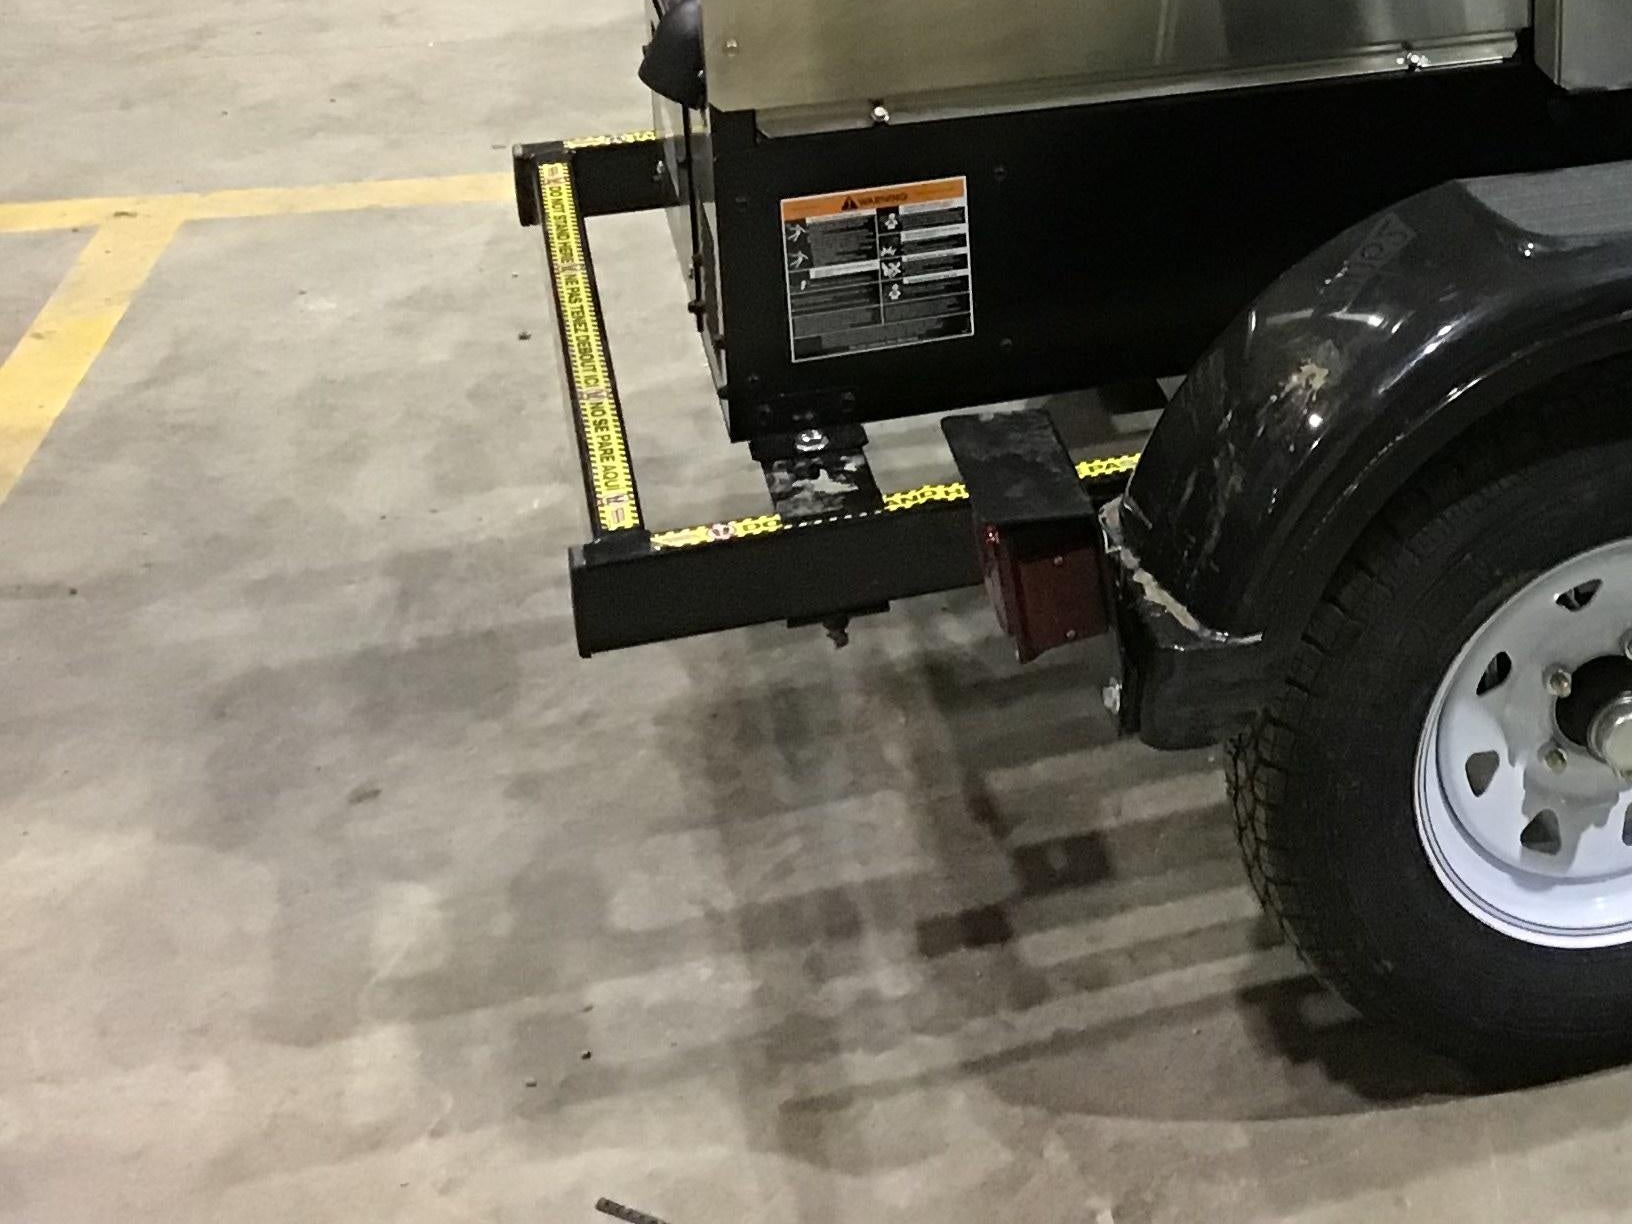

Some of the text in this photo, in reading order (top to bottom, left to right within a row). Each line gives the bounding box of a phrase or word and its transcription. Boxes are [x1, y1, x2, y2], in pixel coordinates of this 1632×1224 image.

[549, 186, 574, 264] DO NOT STAND HERE
[566, 286, 581, 304] PAS
[570, 305, 588, 335] TENEZ
[590, 401, 606, 417] NO
[592, 417, 609, 433] SE
[597, 434, 616, 462] PARE
